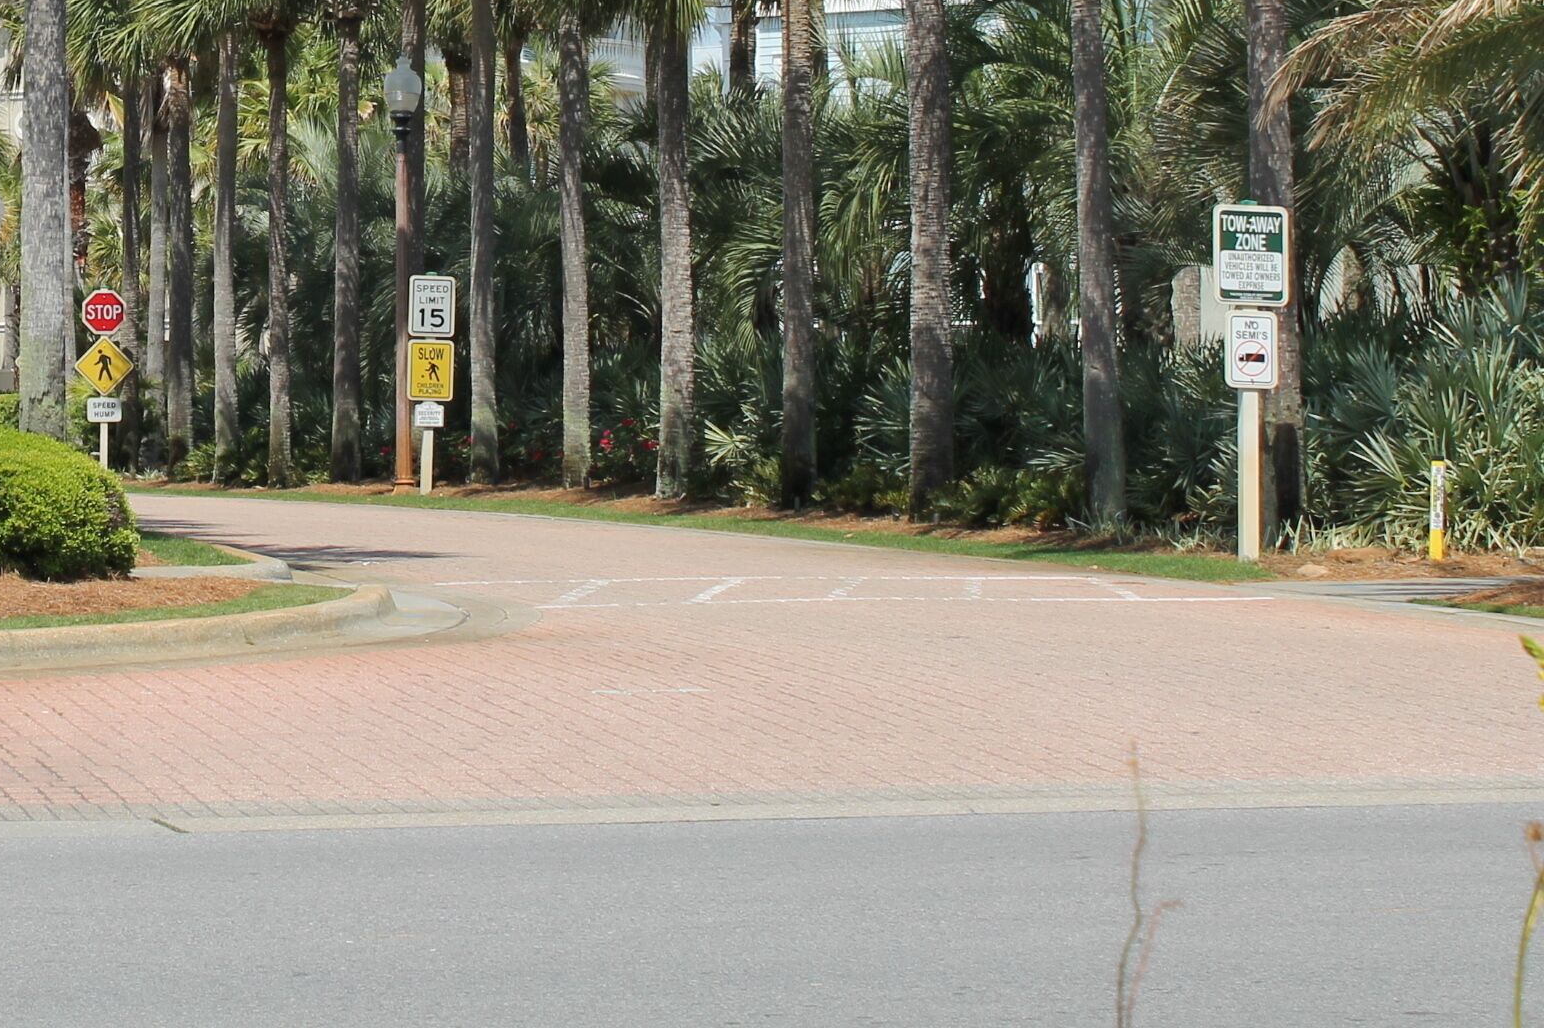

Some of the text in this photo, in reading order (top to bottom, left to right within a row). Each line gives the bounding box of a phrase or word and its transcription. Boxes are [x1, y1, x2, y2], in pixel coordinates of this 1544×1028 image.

[1221, 214, 1281, 233] TOW-AWAY
[1235, 233, 1267, 251] ZONE
[1228, 253, 1275, 262] UNAUTHORIZED
[1225, 262, 1278, 272] VEHICLES WILL BE
[1222, 271, 1281, 282] TOWED AT OWNERS
[416, 284, 449, 293] SPEED
[1238, 281, 1265, 290] EXPENSE
[419, 296, 445, 305] LIMIT
[86, 304, 122, 320] STOP
[419, 308, 445, 328] 15
[1244, 320, 1259, 330] NO
[1235, 330, 1268, 340] SEMI'S
[418, 347, 445, 361] SLOW
